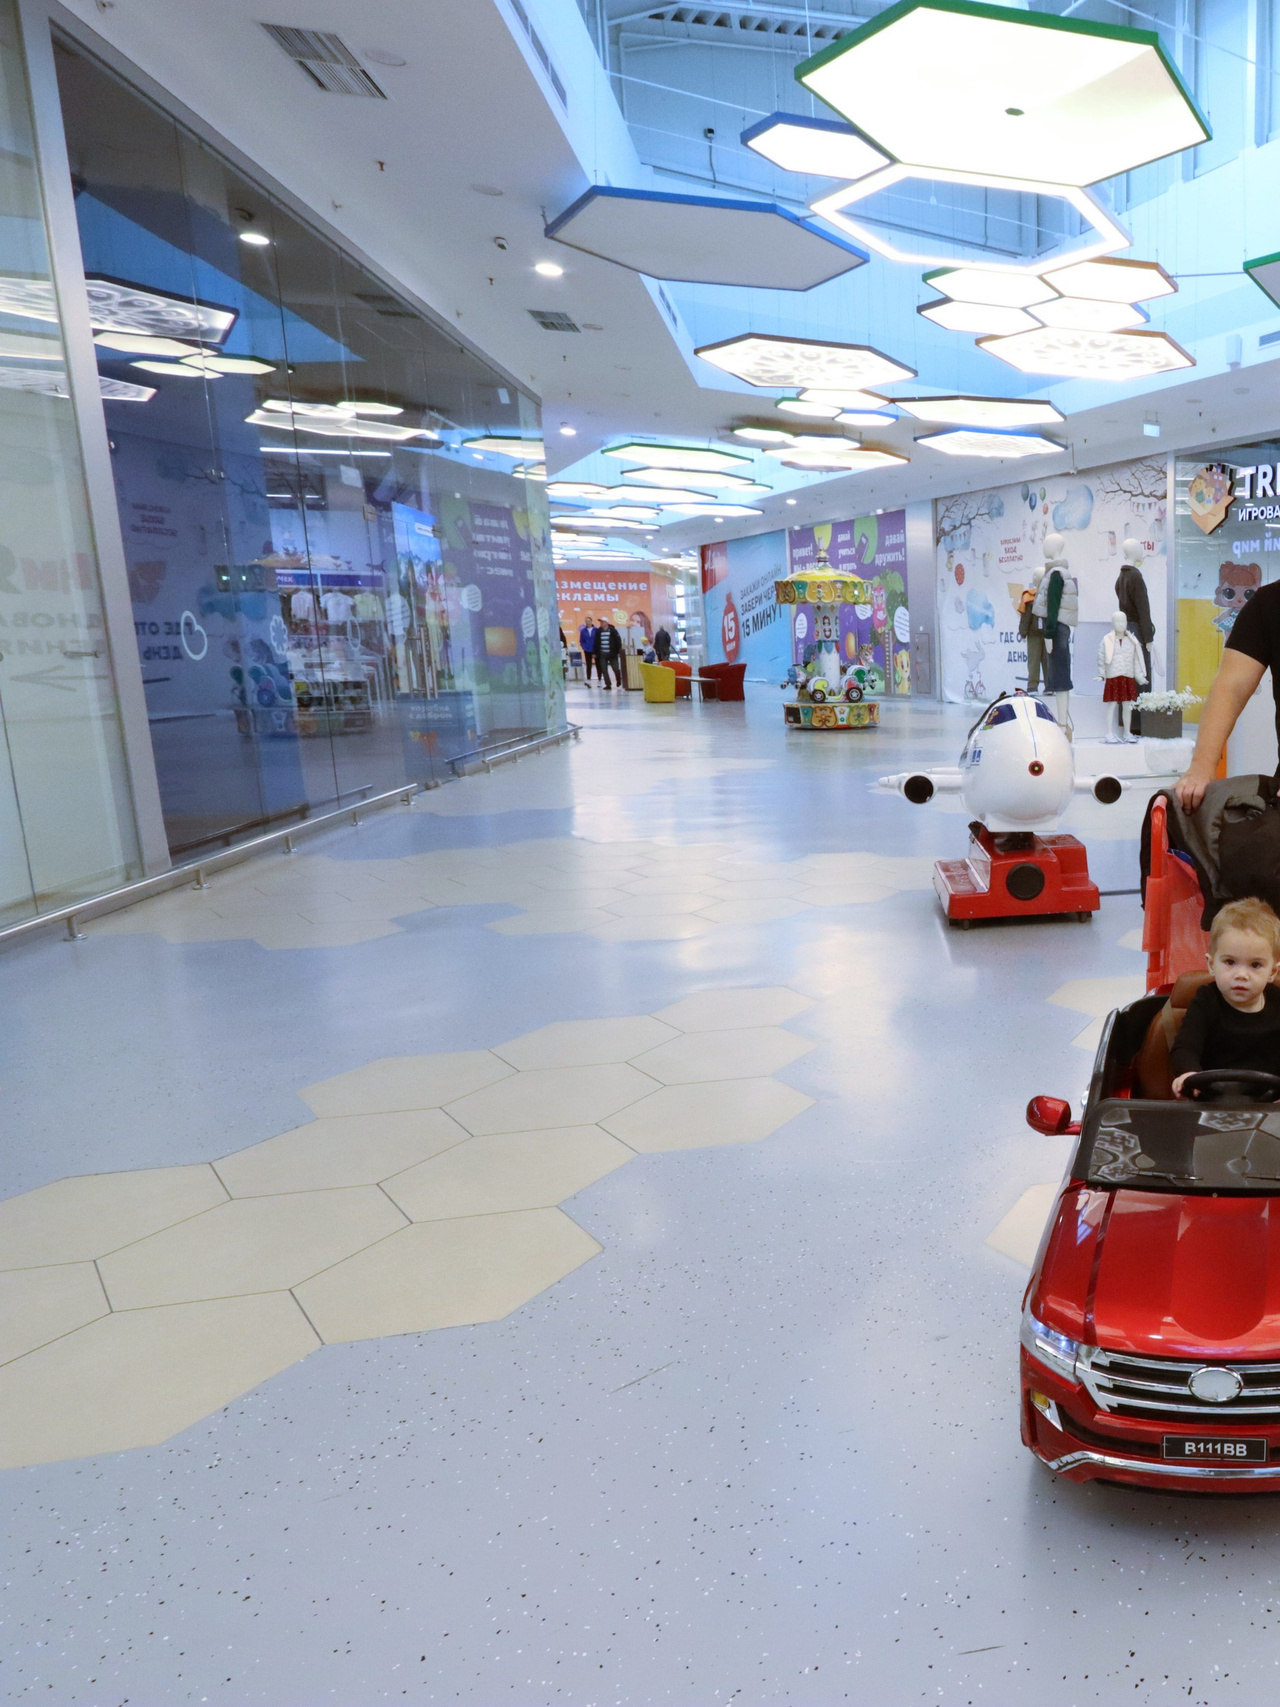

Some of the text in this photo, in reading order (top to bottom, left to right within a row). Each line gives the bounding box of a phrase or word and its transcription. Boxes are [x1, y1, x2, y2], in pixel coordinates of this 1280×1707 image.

[885, 531, 905, 547] давай
[793, 543, 813, 561] привет!
[875, 548, 905, 566] дружить!
[741, 585, 776, 616] ЗАБЕРИ ЧЕР
[723, 611, 735, 642] 15
[742, 618, 750, 638] 15
[1000, 632, 1014, 643] ГДЕ
[1007, 651, 1028, 662] ДЕНЬ
